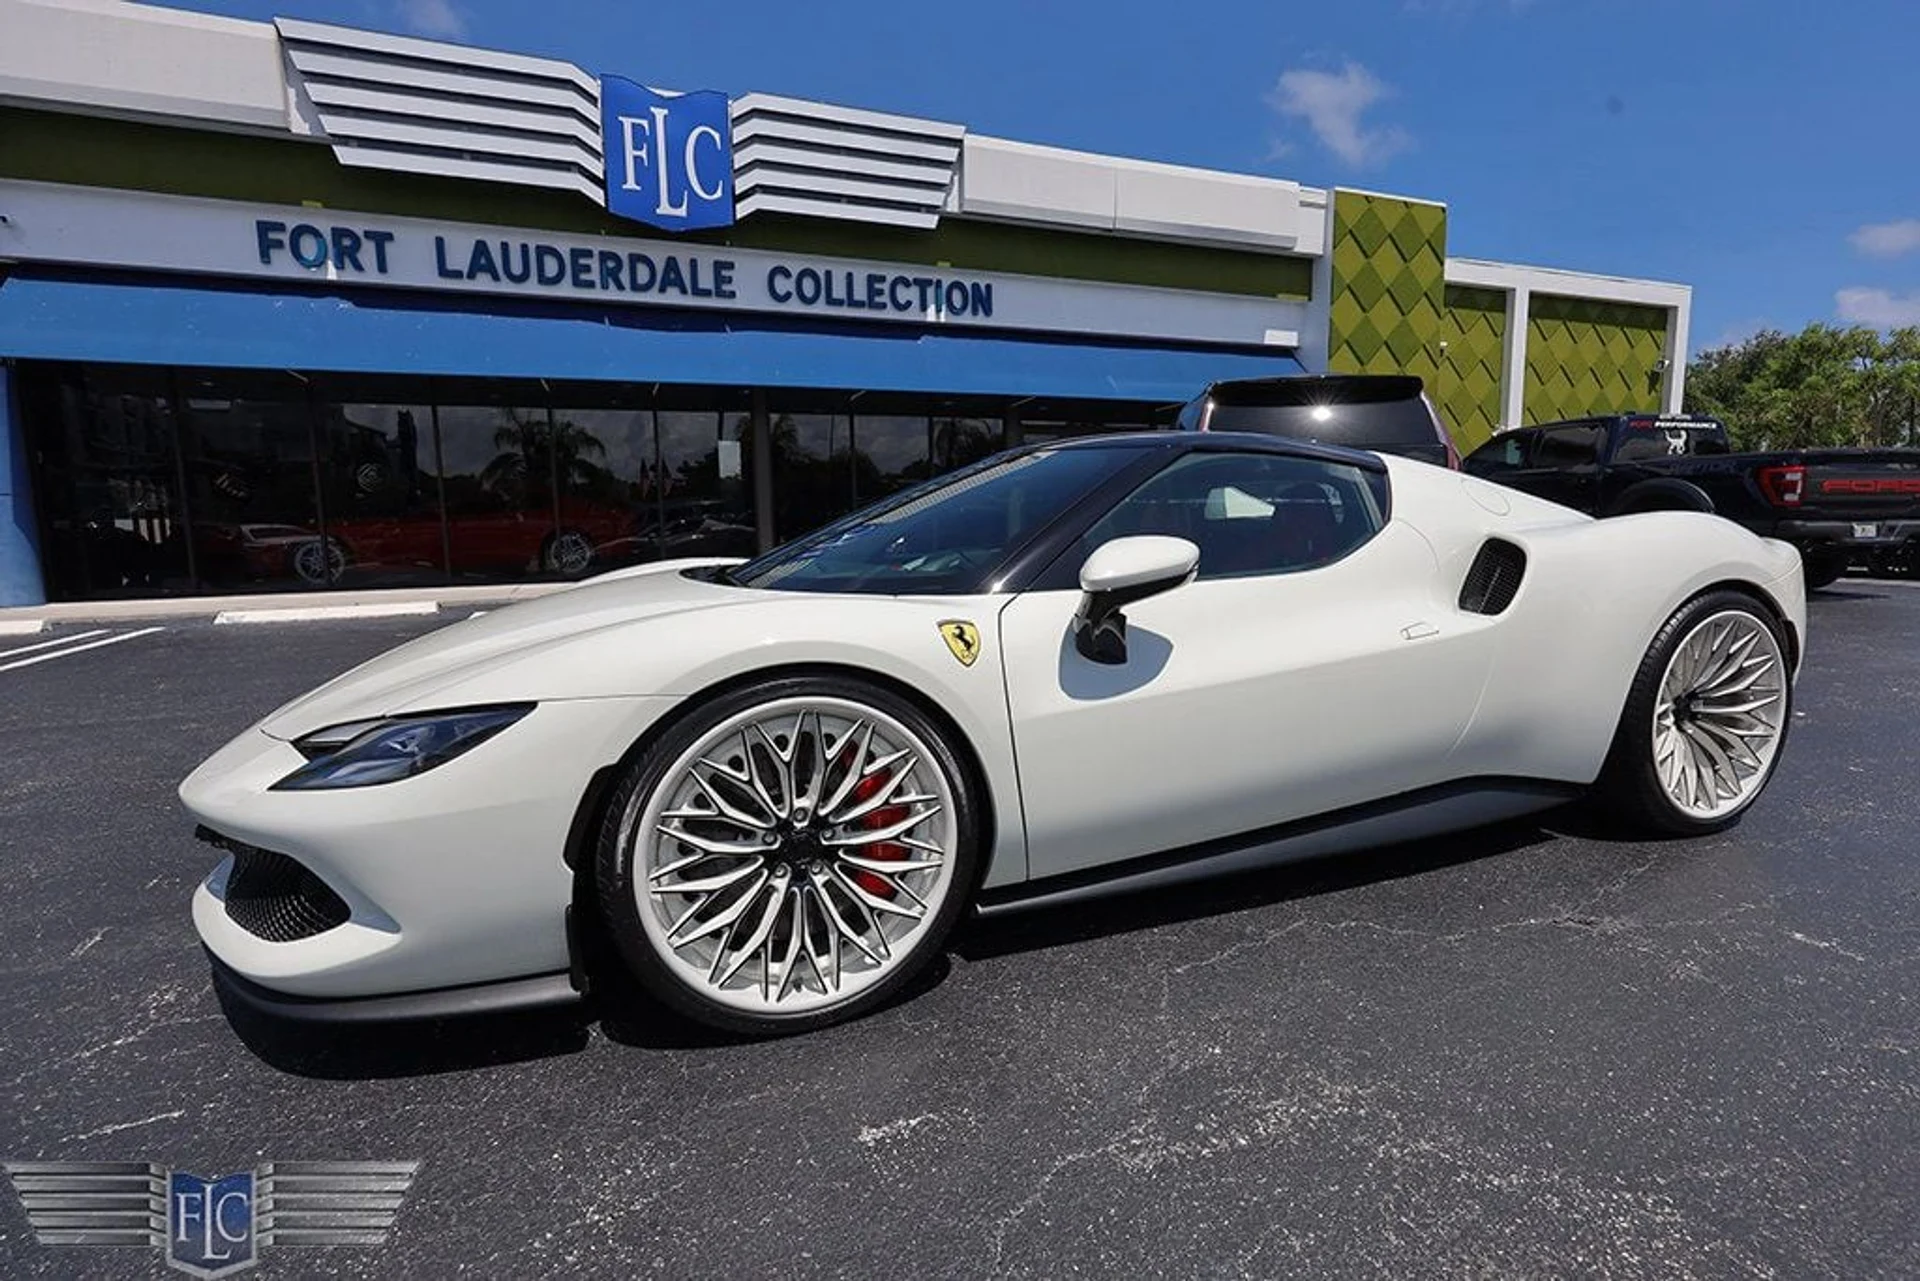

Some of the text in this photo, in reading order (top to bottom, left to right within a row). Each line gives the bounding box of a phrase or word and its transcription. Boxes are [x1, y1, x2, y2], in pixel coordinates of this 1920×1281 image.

[617, 105, 723, 218] FLC
[255, 219, 994, 318] FORT LAUDERDALE COLLECTION
